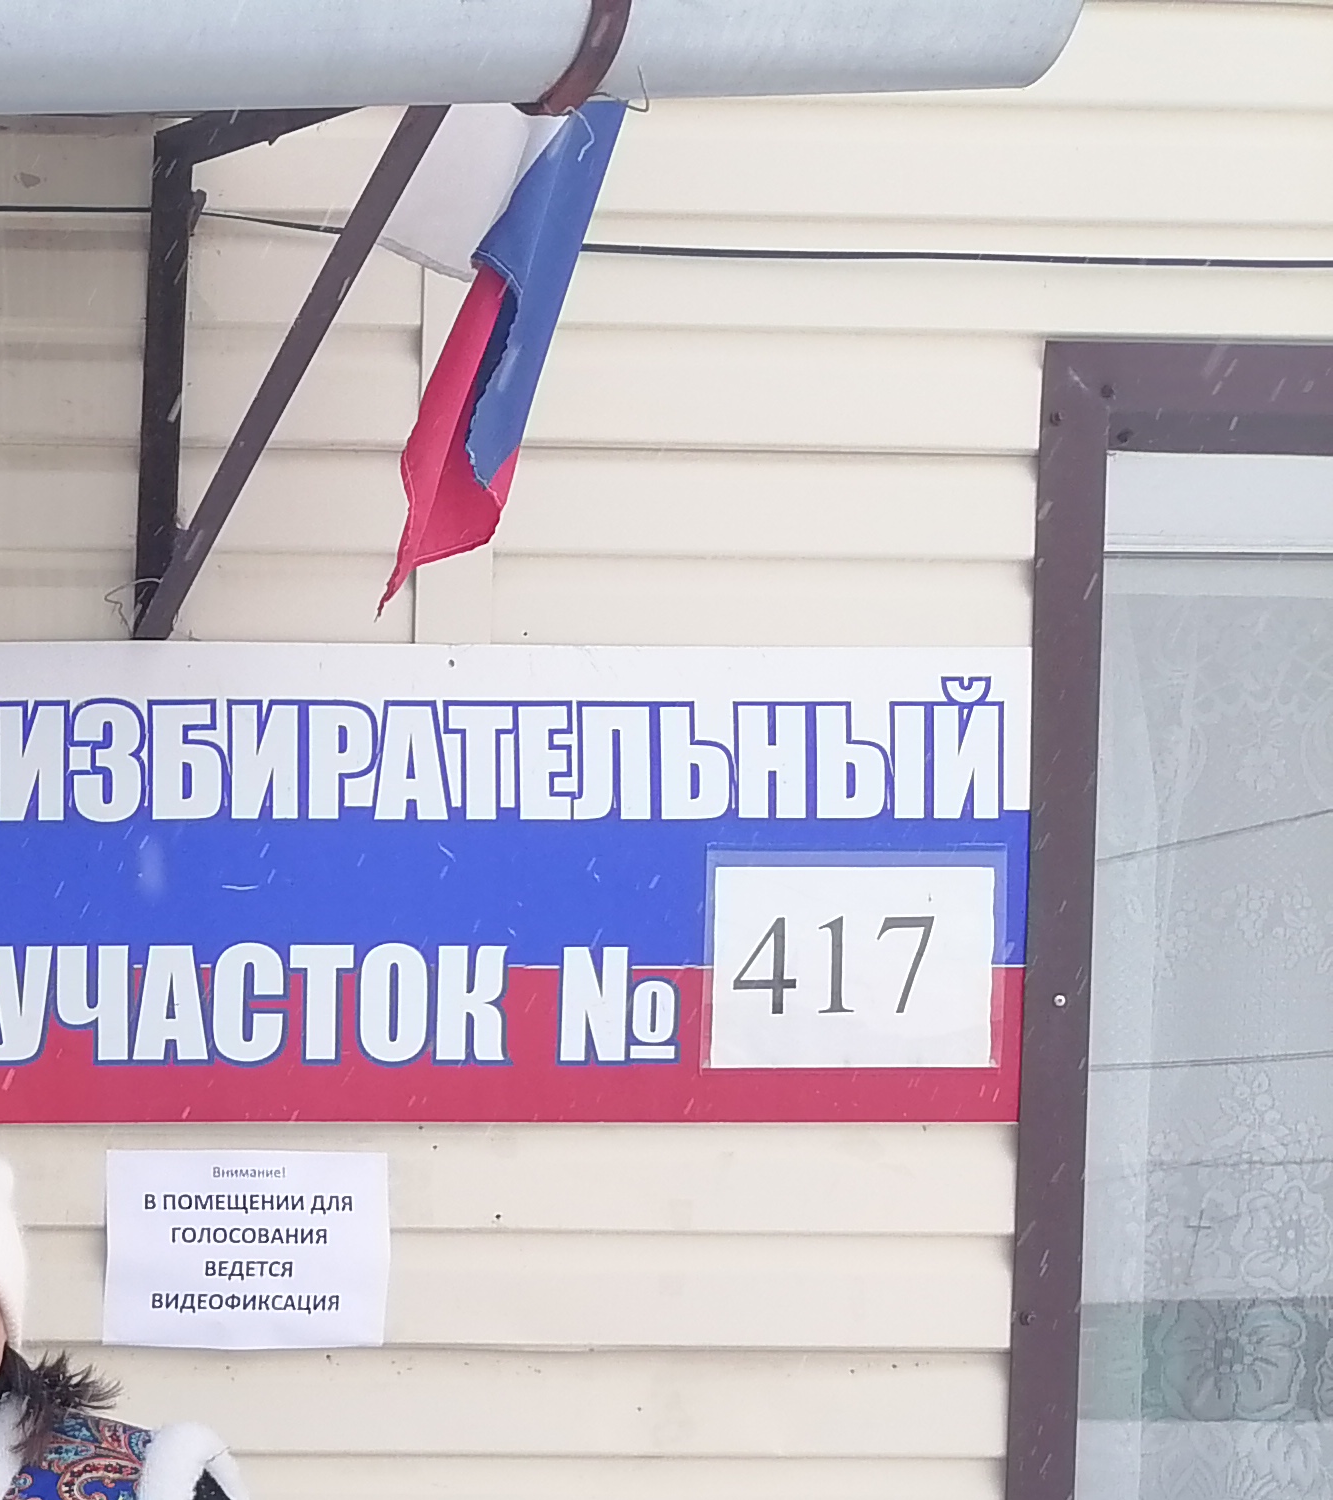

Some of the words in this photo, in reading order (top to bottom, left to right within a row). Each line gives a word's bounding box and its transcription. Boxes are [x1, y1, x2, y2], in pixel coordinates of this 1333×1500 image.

[733, 915, 935, 1014] 417
[212, 1167, 286, 1179] Внимание!
[144, 1194, 156, 1210] В
[163, 1194, 304, 1214] ПОМЕЩЕНИИ
[310, 1195, 353, 1214] ДЛЯ
[171, 1227, 328, 1244] ГОЛОСОВАНИЯ
[205, 1261, 293, 1281] ВЕДЕТСЯ
[151, 1293, 339, 1314] ВИДЕОФИКСАЦИЯ
